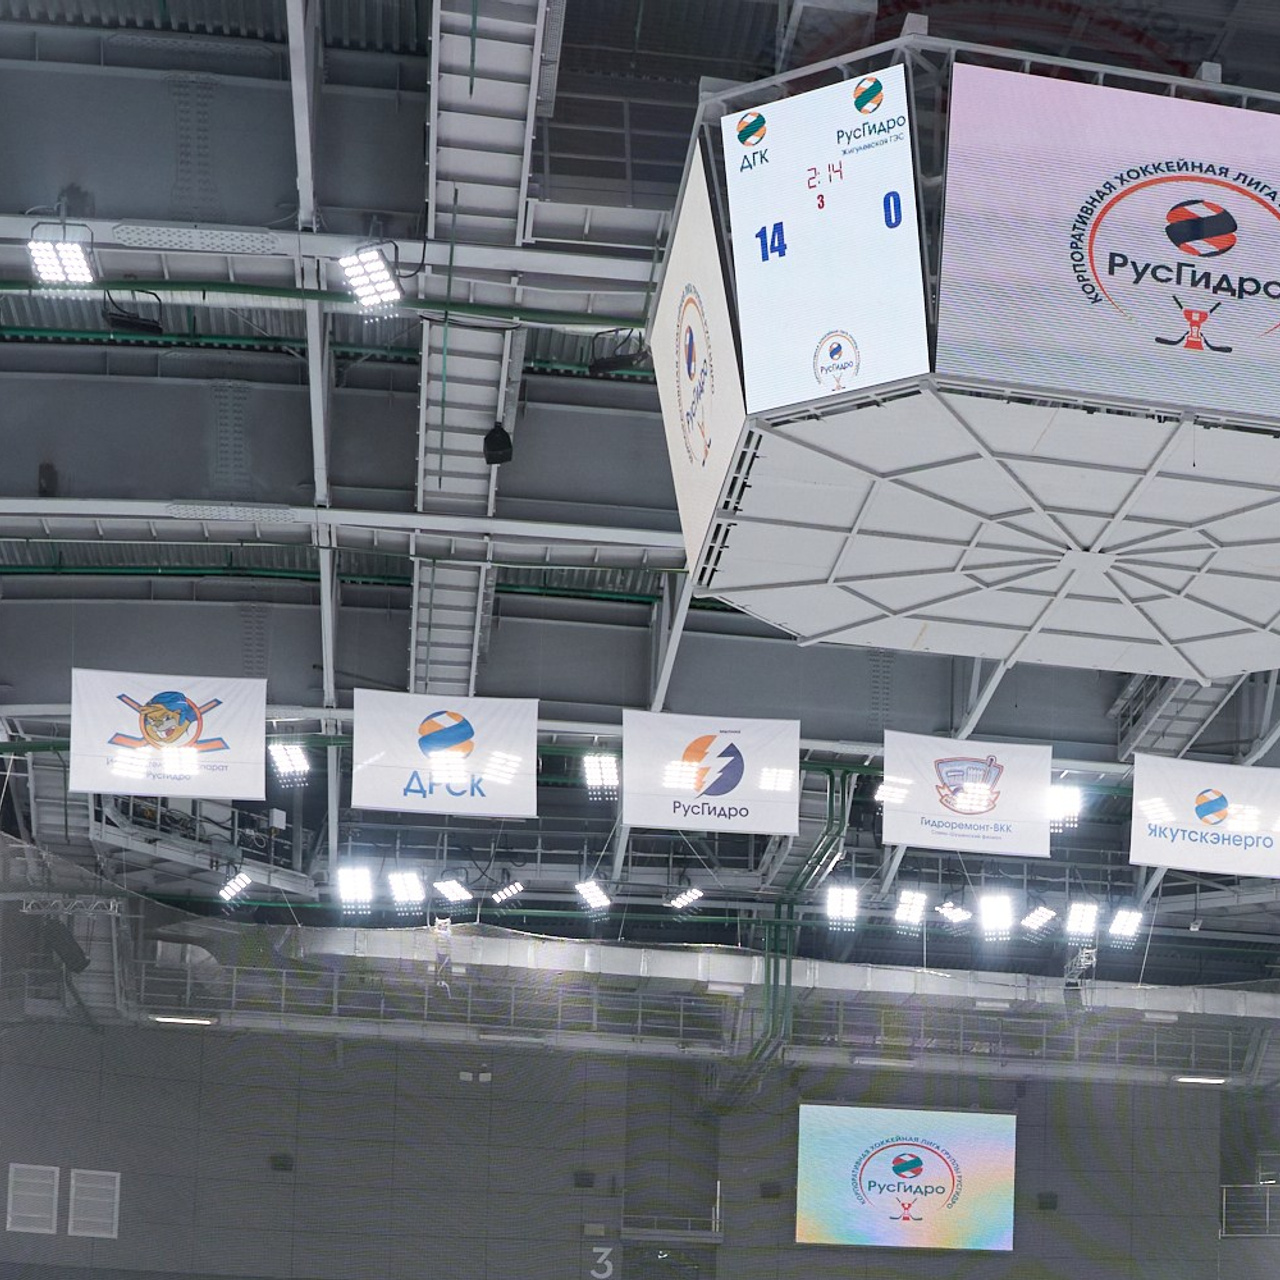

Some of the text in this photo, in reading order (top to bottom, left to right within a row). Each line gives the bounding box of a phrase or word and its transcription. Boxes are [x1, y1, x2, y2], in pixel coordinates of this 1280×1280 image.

[837, 115, 906, 145] РусГидро
[740, 148, 769, 172] ДГК
[816, 194, 825, 210] 3
[883, 191, 902, 229] 0
[755, 221, 787, 262] 14
[1070, 181, 1117, 305] КОРПОРАТИВНАЯ
[1114, 158, 1230, 186] ХОККЕЙНАЯ
[1233, 171, 1279, 202] ЛИГА
[673, 801, 749, 820] РусГидро
[920, 816, 1012, 833] Гидроремонт-ВКК
[1148, 823, 1274, 850] Якутскэнерго
[867, 1180, 946, 1197] РусГидро
[590, 1247, 612, 1279] 3
